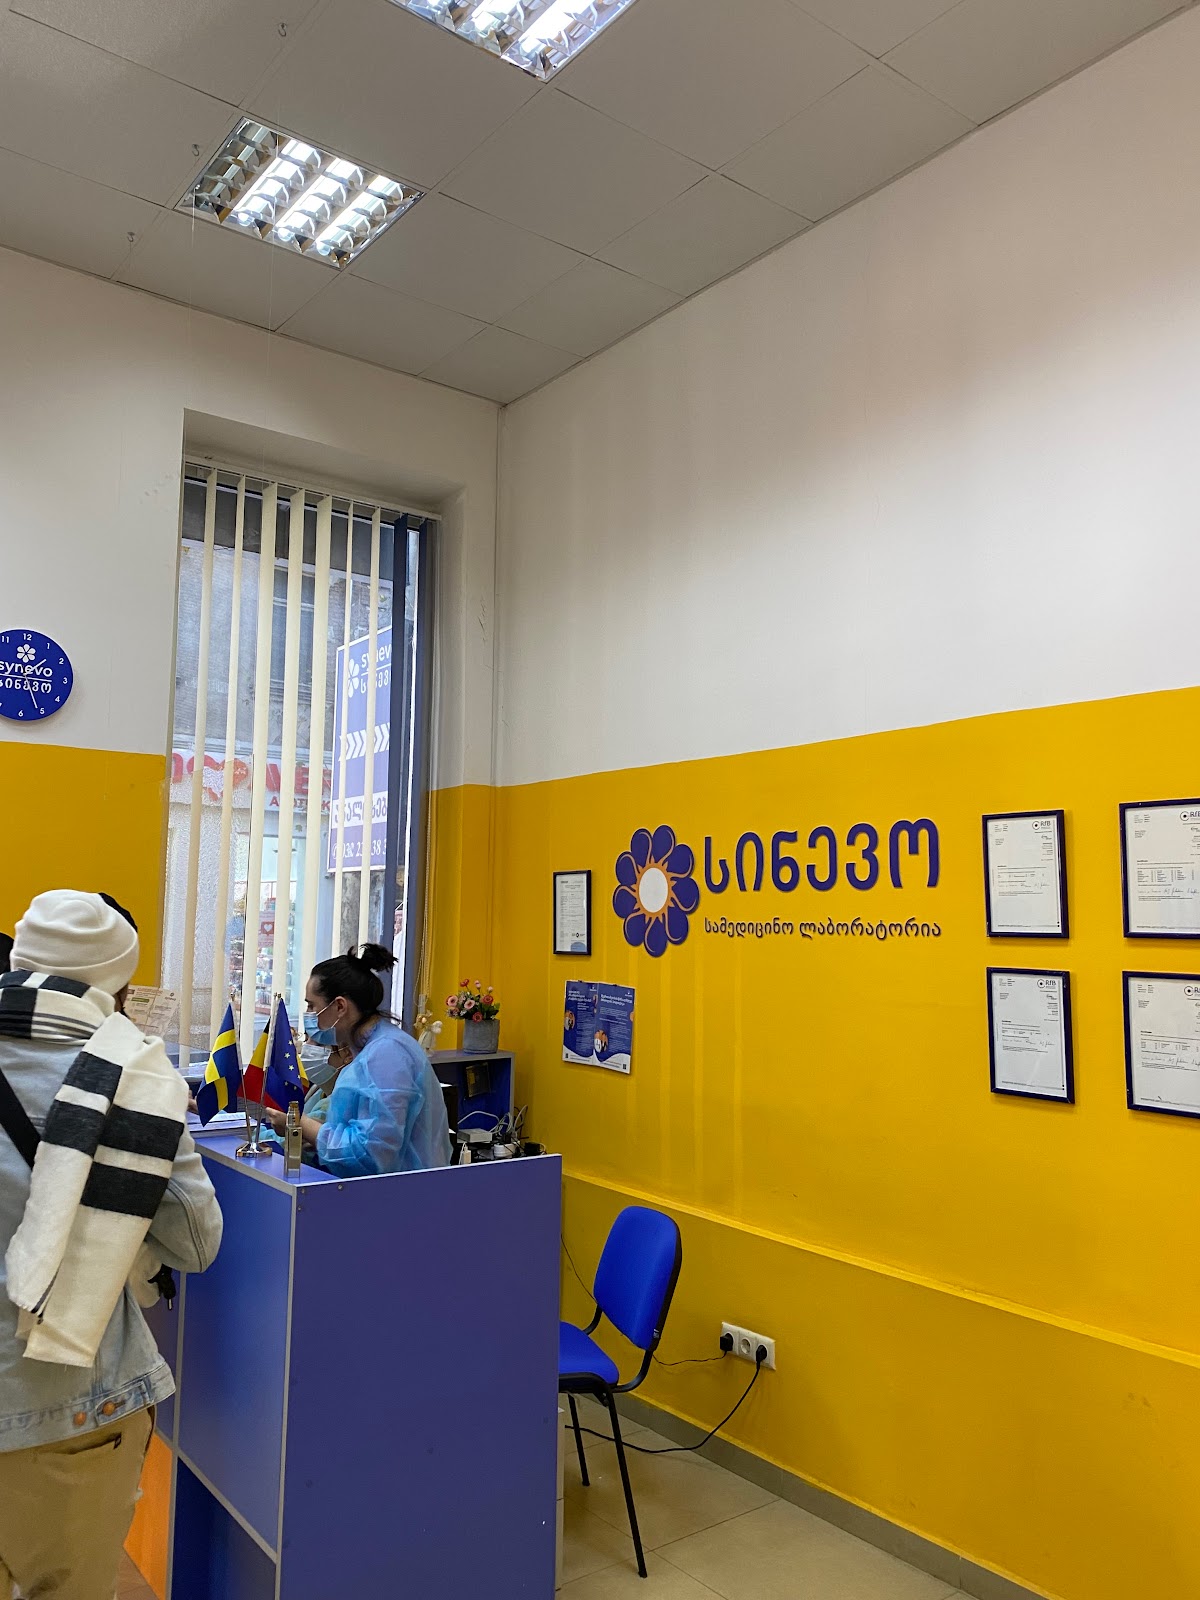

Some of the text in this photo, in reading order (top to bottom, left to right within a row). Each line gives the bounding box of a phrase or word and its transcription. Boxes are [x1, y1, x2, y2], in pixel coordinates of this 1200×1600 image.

[703, 817, 939, 893] სინევო
[704, 917, 942, 940] სამედიცინო ლაბორატორია
